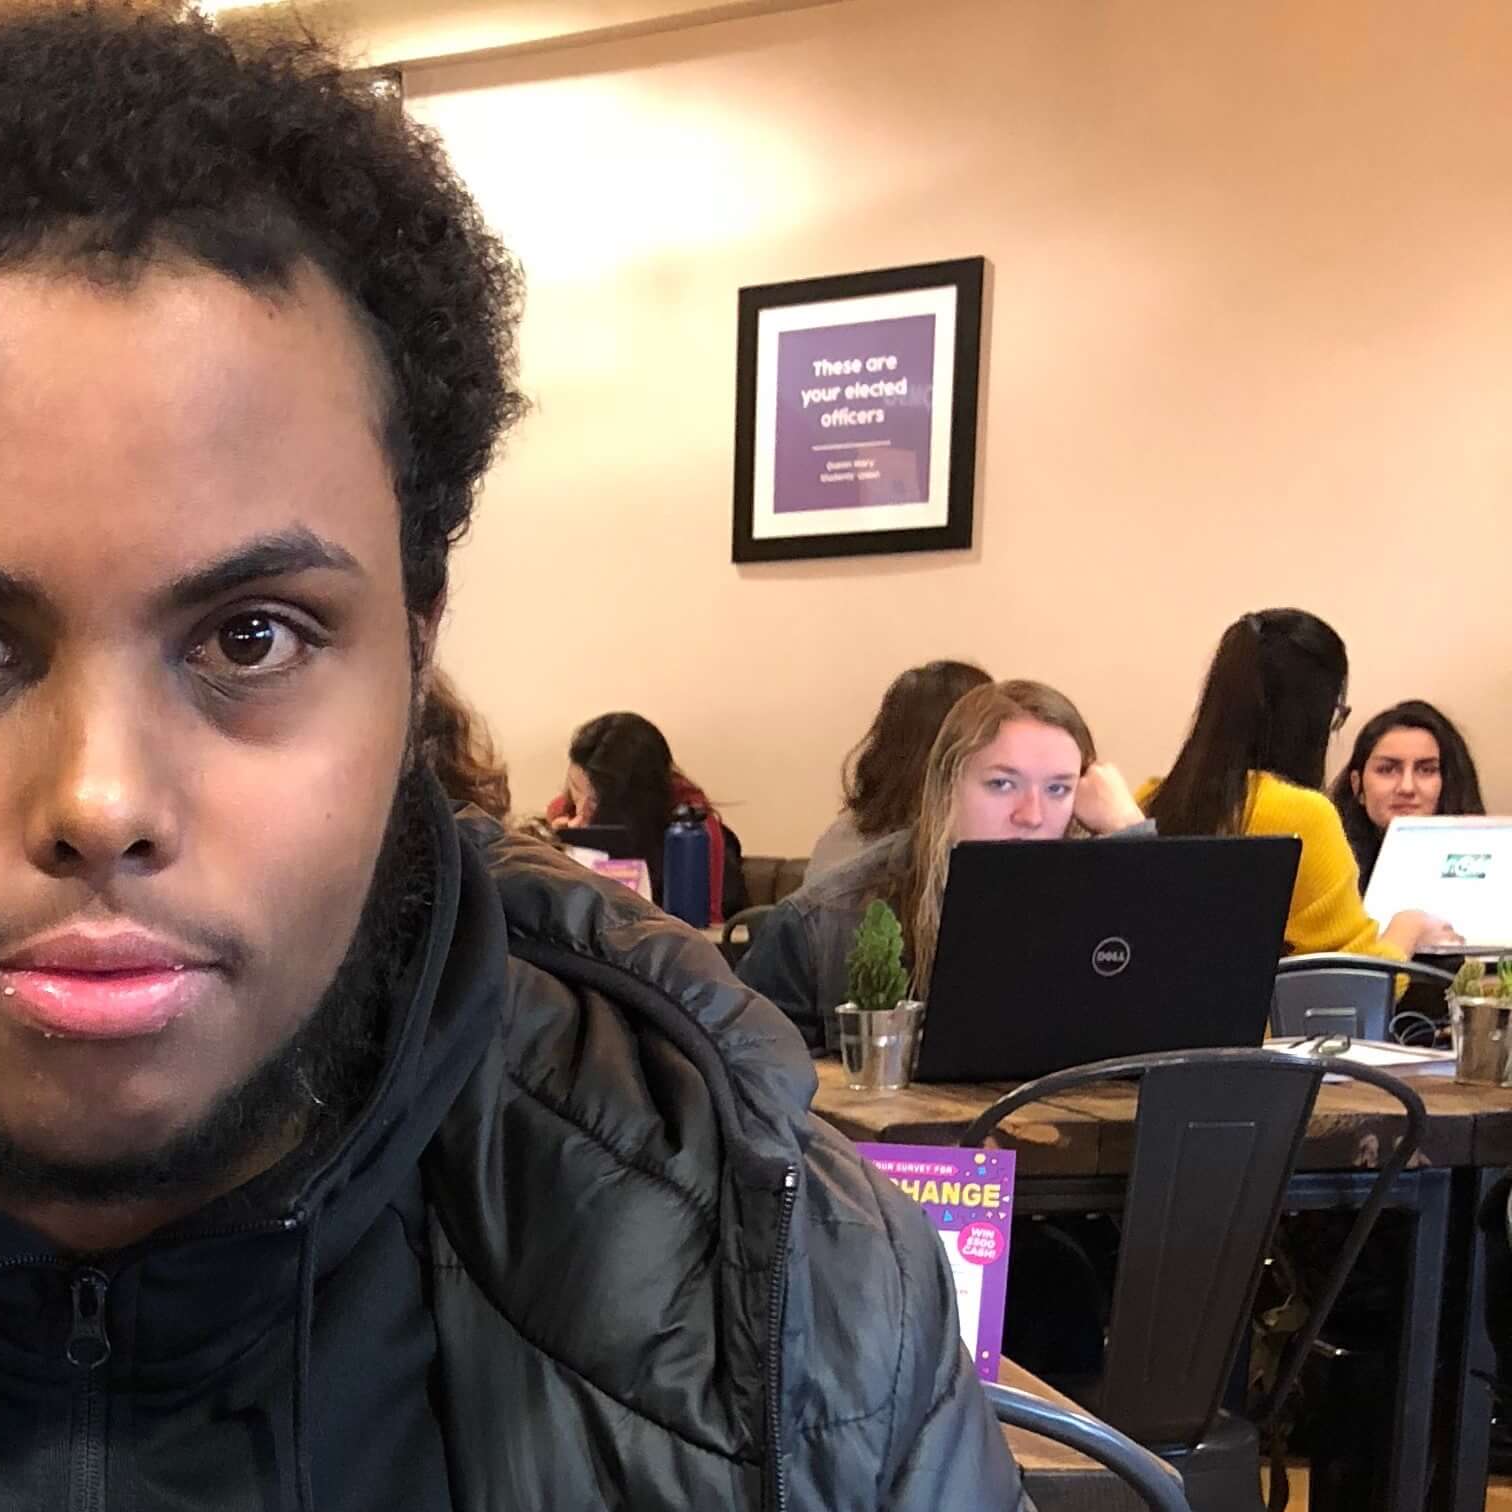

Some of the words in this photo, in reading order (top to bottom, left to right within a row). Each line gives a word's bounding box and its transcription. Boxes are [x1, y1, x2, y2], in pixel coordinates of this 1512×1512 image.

[813, 358, 862, 377] These
[865, 355, 898, 372] are
[801, 386, 841, 409] your
[844, 376, 908, 400] elected
[820, 407, 885, 428] officers
[1096, 951, 1126, 962] DELL
[890, 1178, 1001, 1208] HANGE
